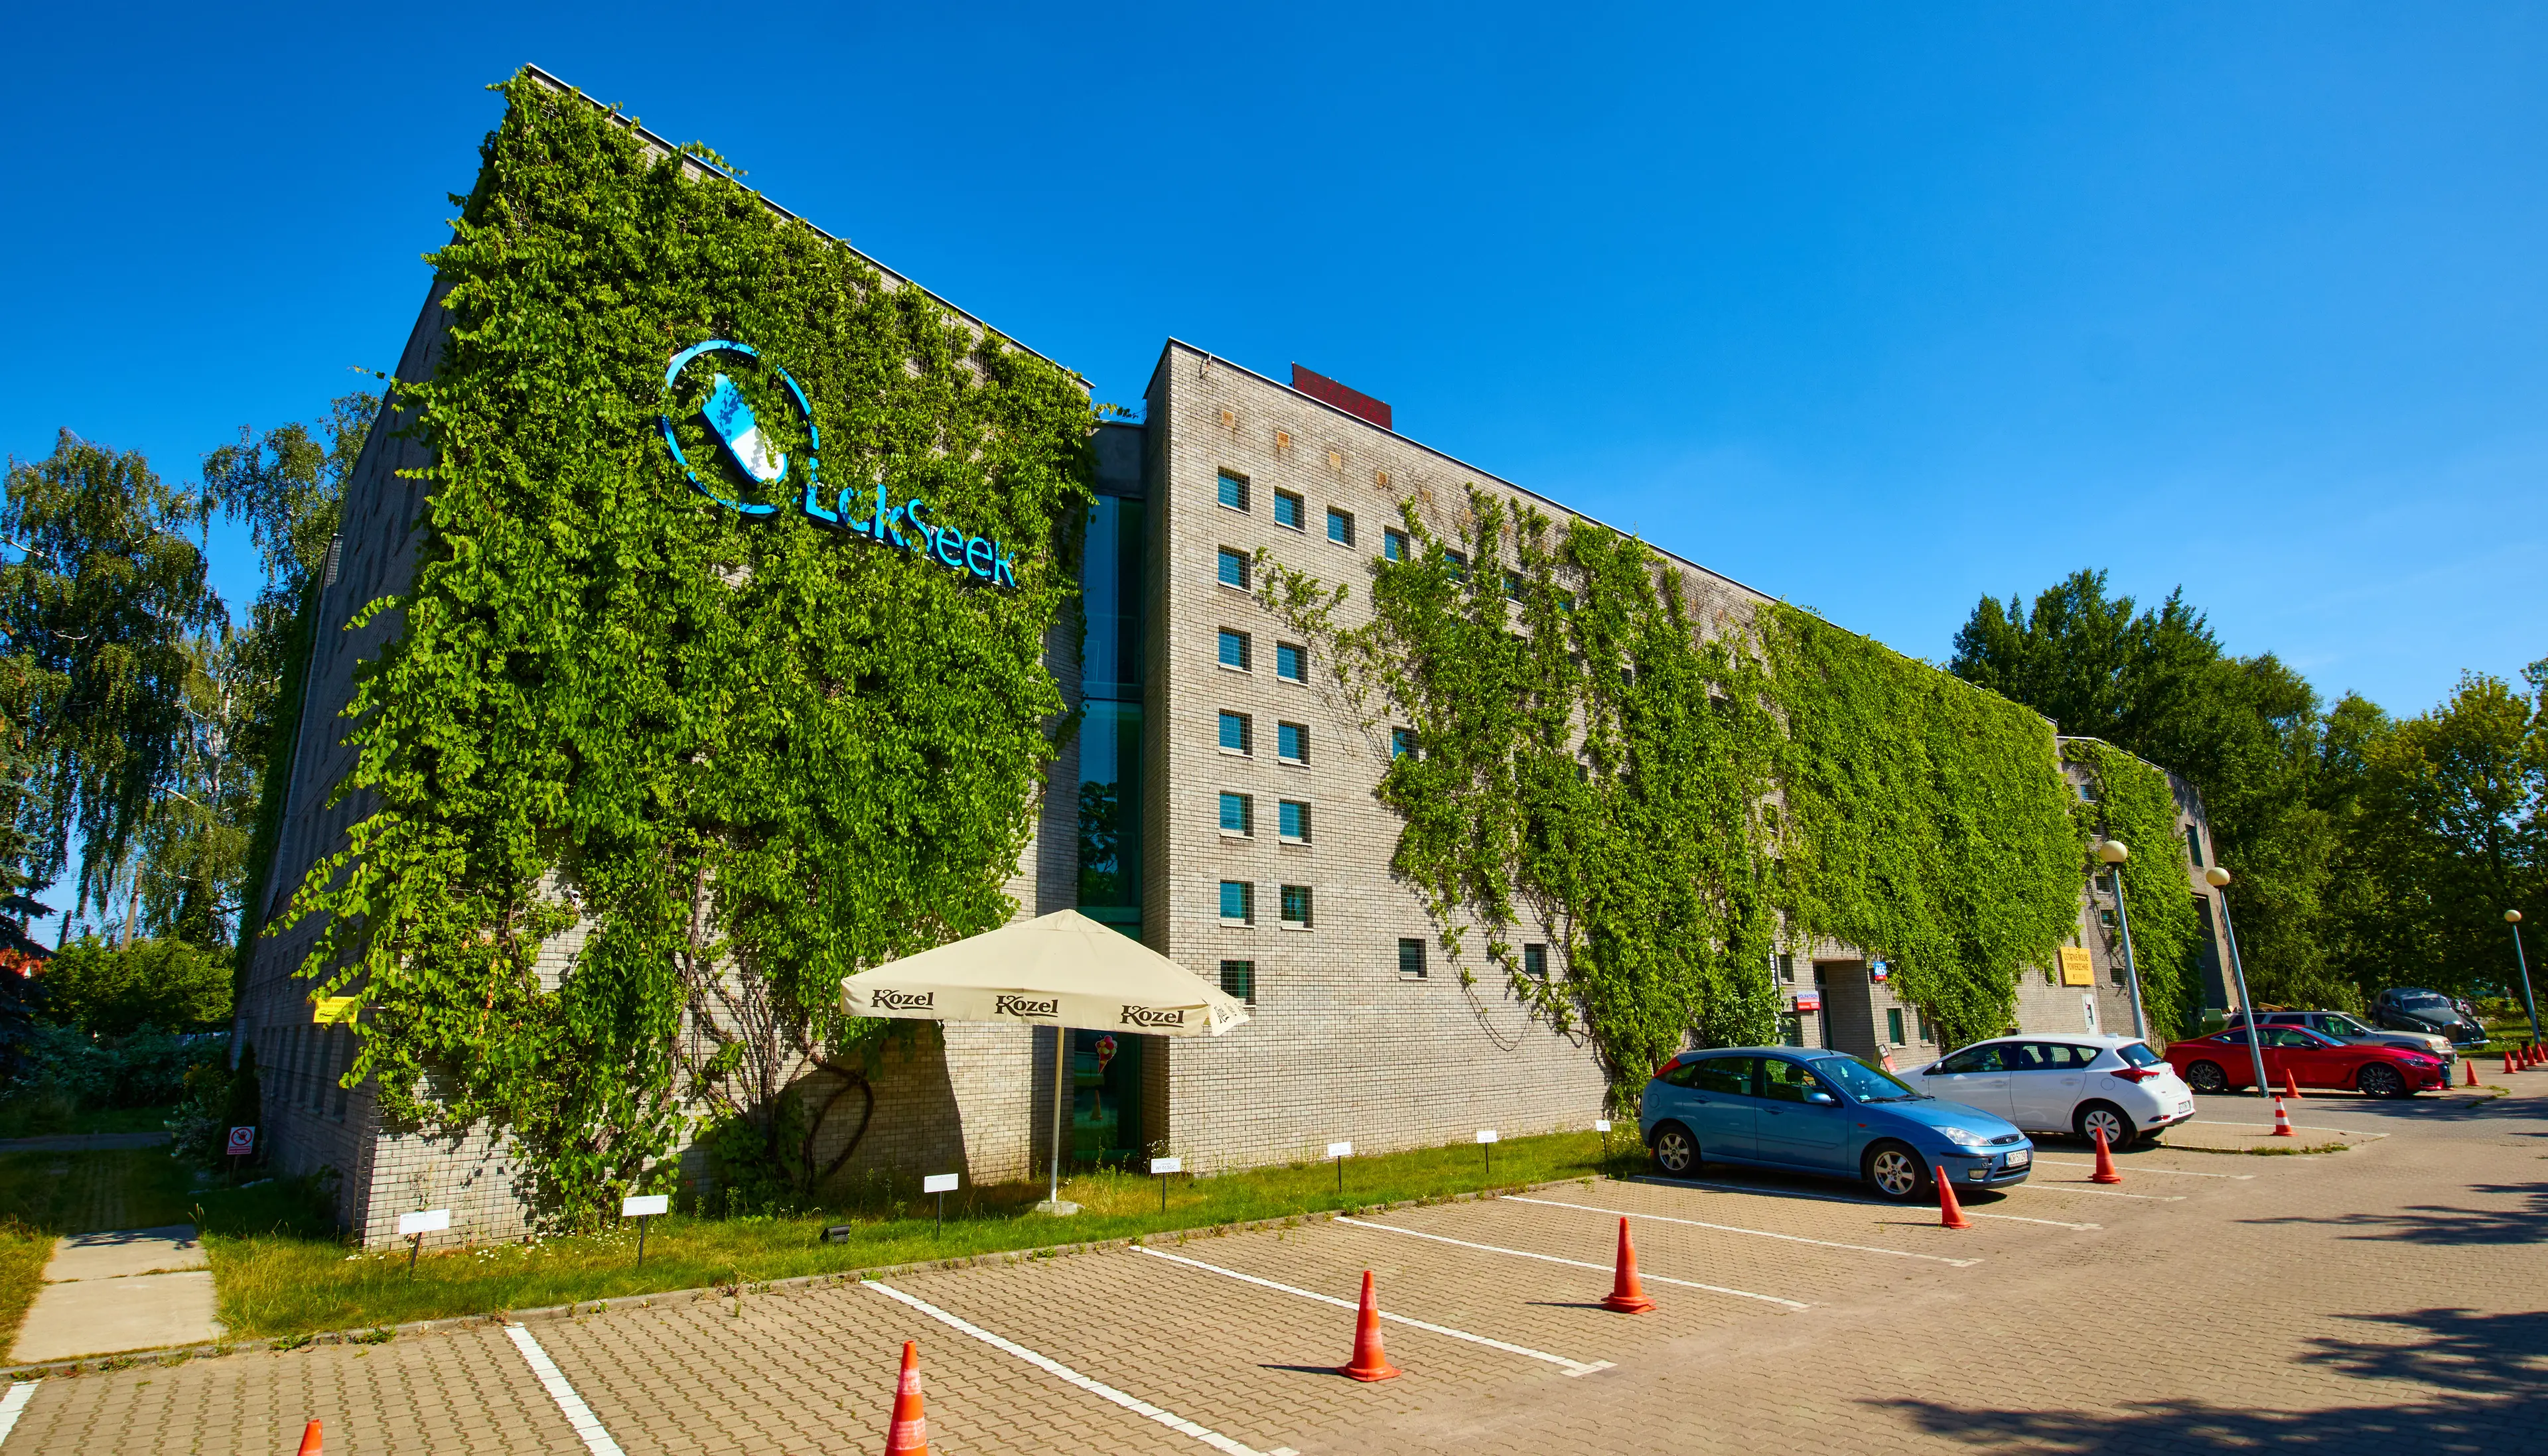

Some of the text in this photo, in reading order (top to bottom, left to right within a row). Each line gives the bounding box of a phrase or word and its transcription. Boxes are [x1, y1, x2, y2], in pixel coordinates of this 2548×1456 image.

[870, 989, 934, 1010] Kozel
[994, 995, 1059, 1018] Kozel
[1119, 1005, 1184, 1028] Kozel
